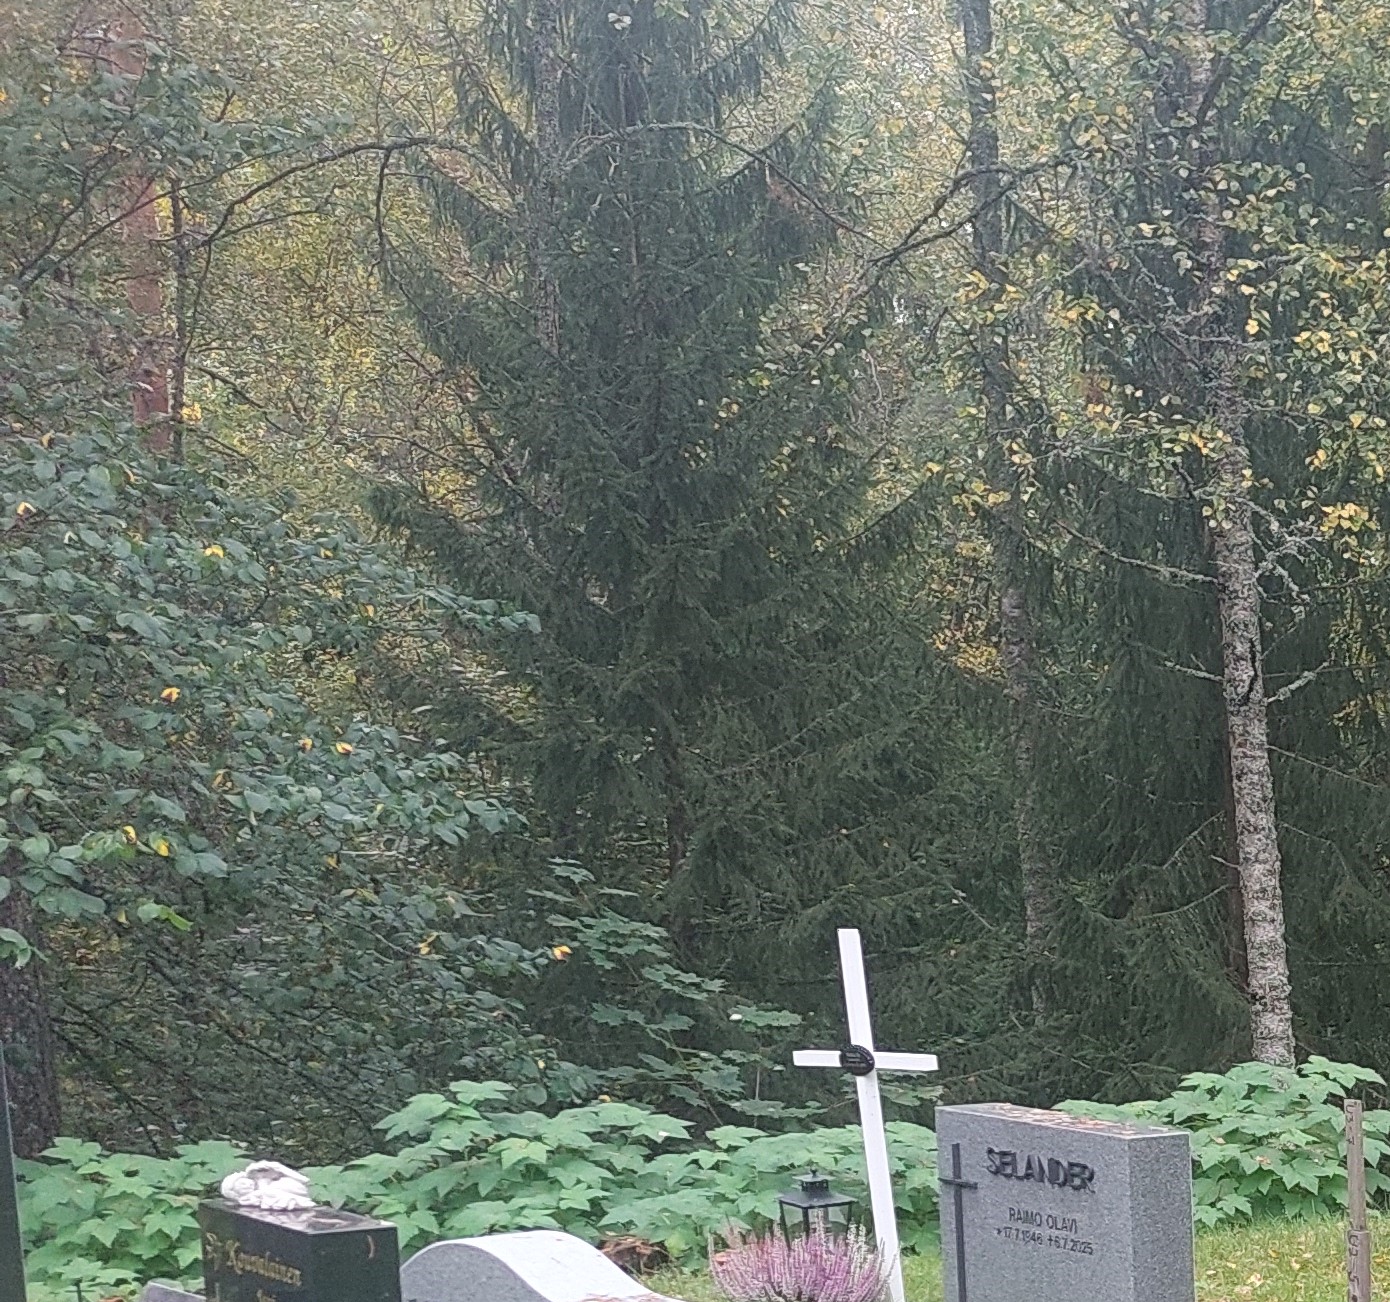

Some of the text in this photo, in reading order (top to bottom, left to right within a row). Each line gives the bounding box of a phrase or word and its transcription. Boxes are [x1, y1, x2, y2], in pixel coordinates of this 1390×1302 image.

[986, 1146, 1096, 1194] SELANDER
[1008, 1207, 1078, 1234] RAIMO OLAVI
